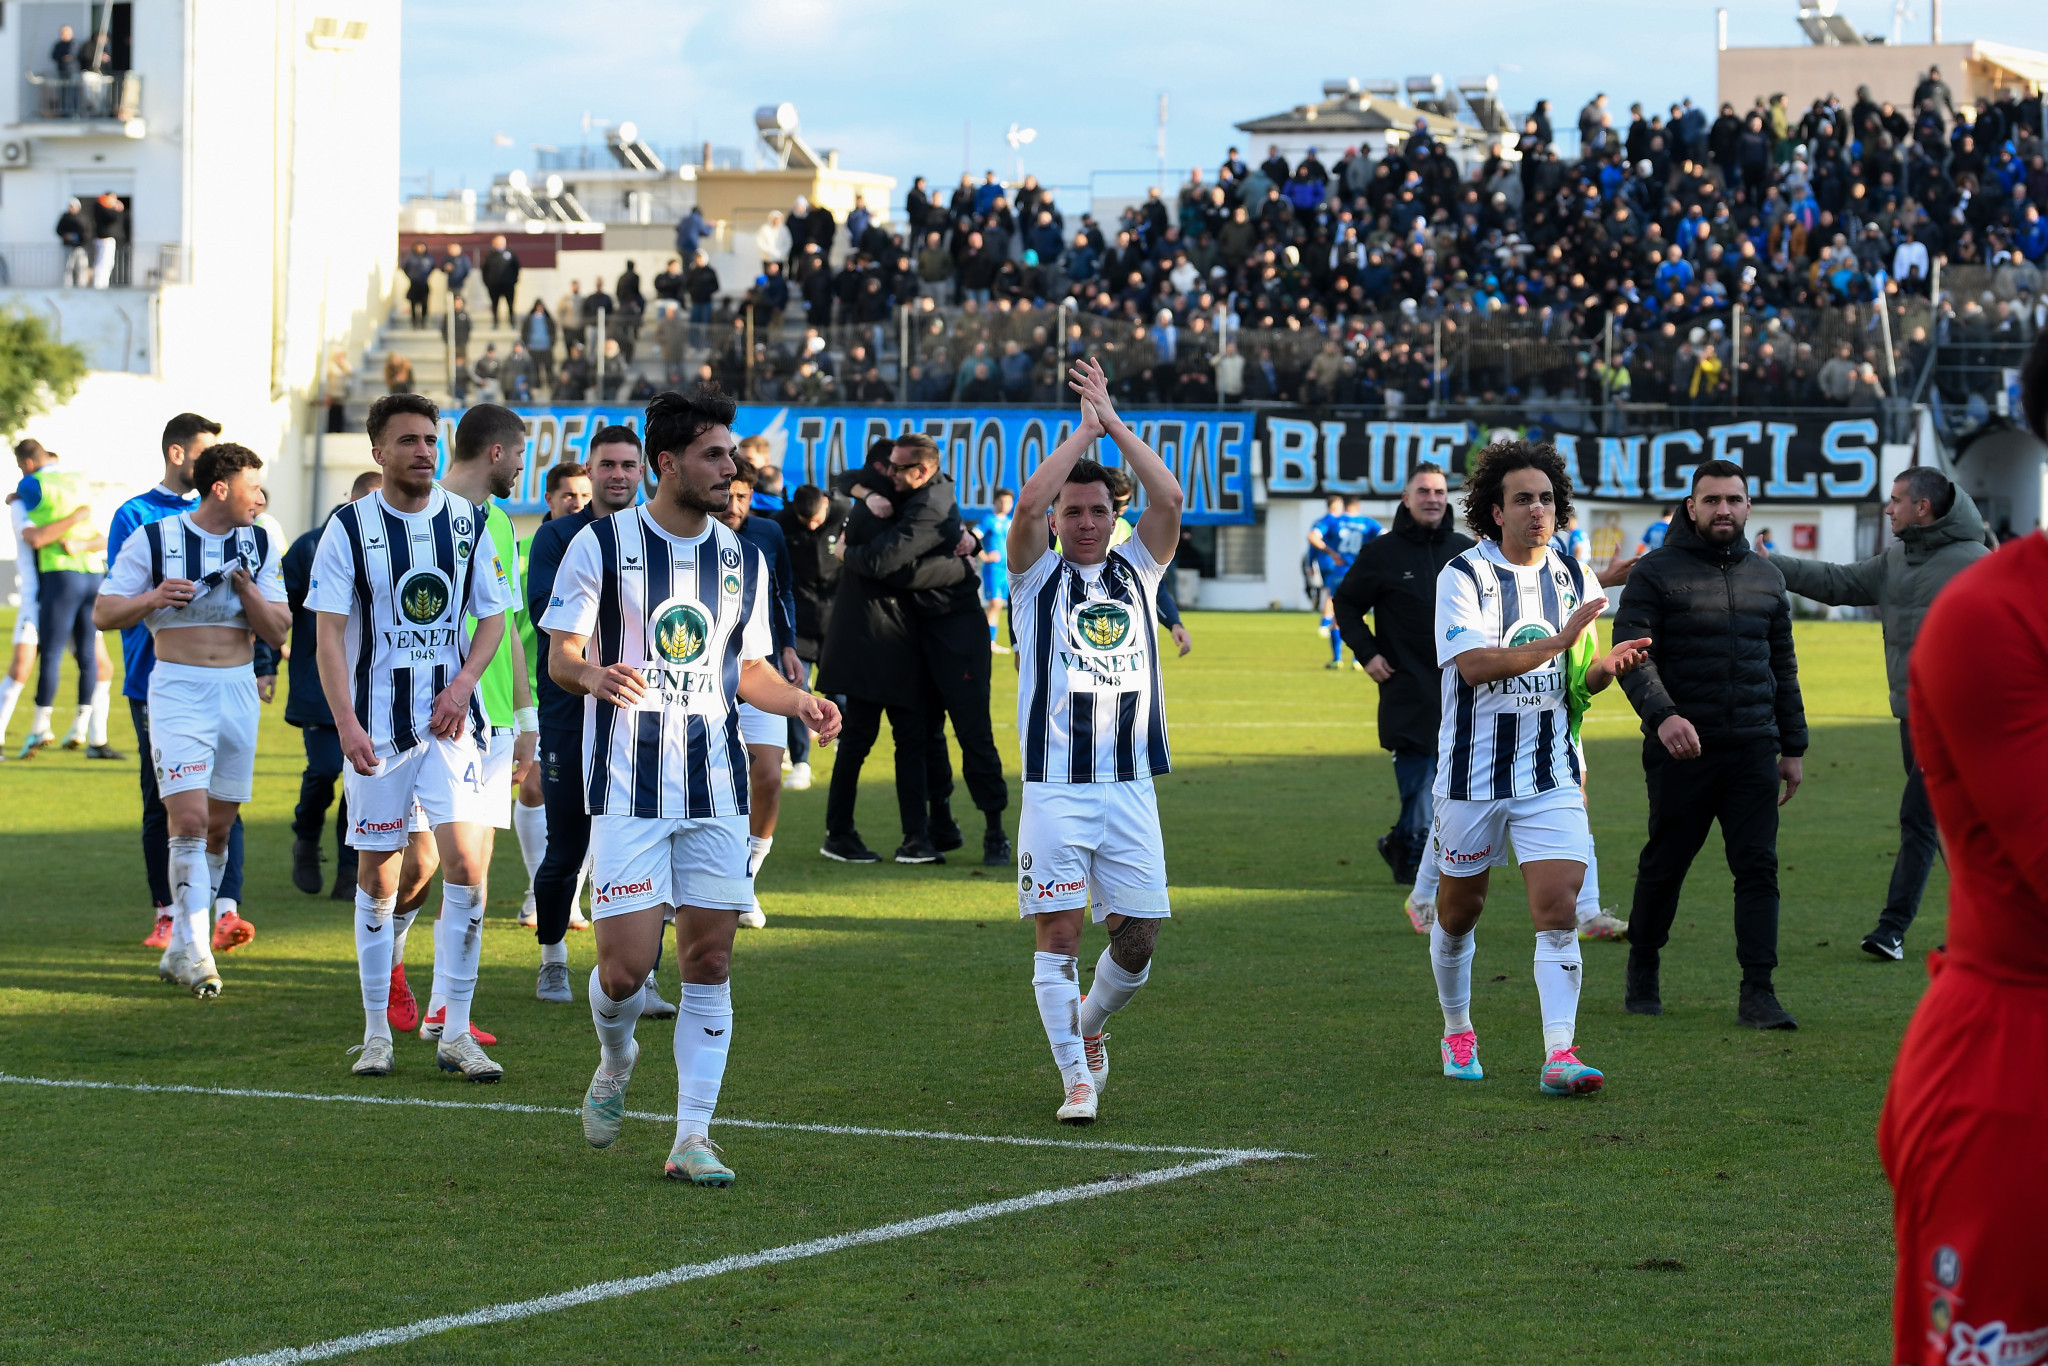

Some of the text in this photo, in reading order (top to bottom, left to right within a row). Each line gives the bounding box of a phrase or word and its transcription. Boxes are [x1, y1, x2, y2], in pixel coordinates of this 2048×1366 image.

[1266, 417, 1879, 499] BLUE ANGELS
[383, 628, 457, 650] VENETI
[410, 649, 435, 661] 1948
[1093, 674, 1122, 686] 1948
[1487, 672, 1562, 694] VENETI
[661, 693, 689, 707] 1948
[1516, 695, 1542, 707] 1948
[464, 762, 479, 793] 4
[367, 818, 403, 831] mexil
[1457, 845, 1490, 861] mexil
[611, 877, 652, 896] mexil
